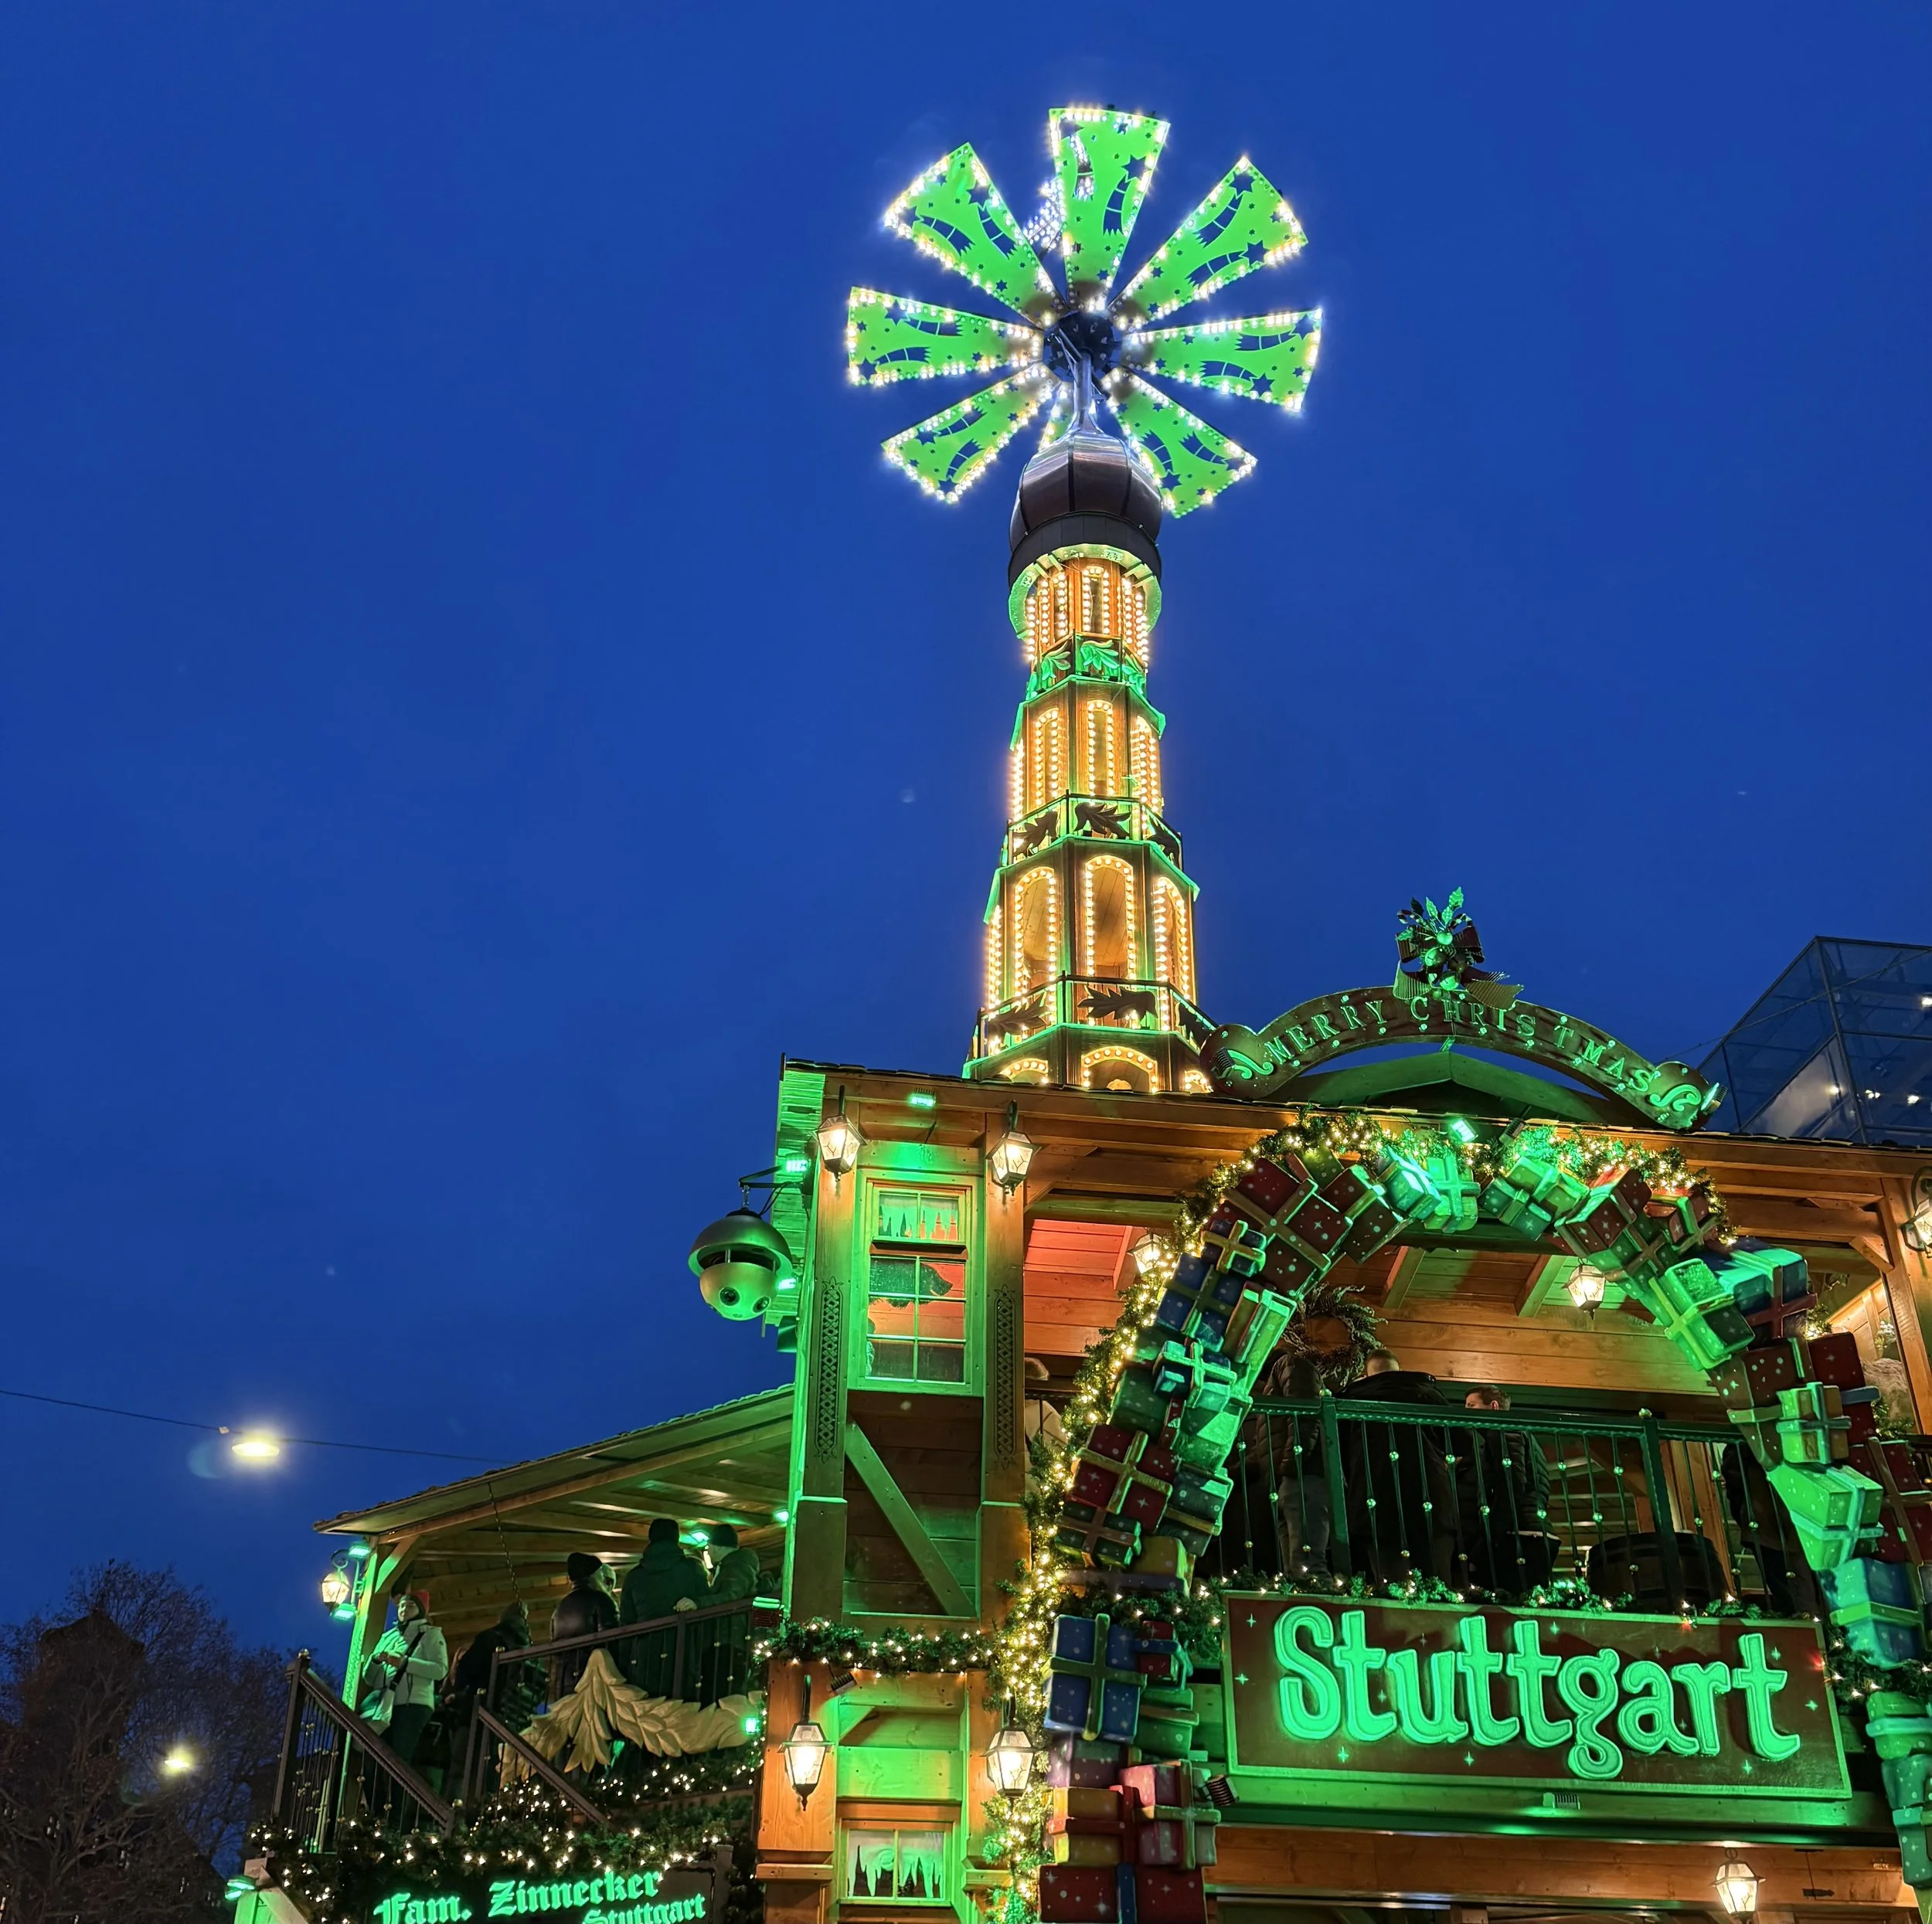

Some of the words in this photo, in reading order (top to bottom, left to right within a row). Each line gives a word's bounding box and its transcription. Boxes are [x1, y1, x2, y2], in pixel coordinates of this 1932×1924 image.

[1264, 999, 1386, 1066] MERRY
[1410, 995, 1653, 1093] CHRISTMAS
[1274, 1605, 1801, 1780] Stuttgart
[373, 1892, 472, 1924] Fam.
[488, 1870, 662, 1917] Zinnecker
